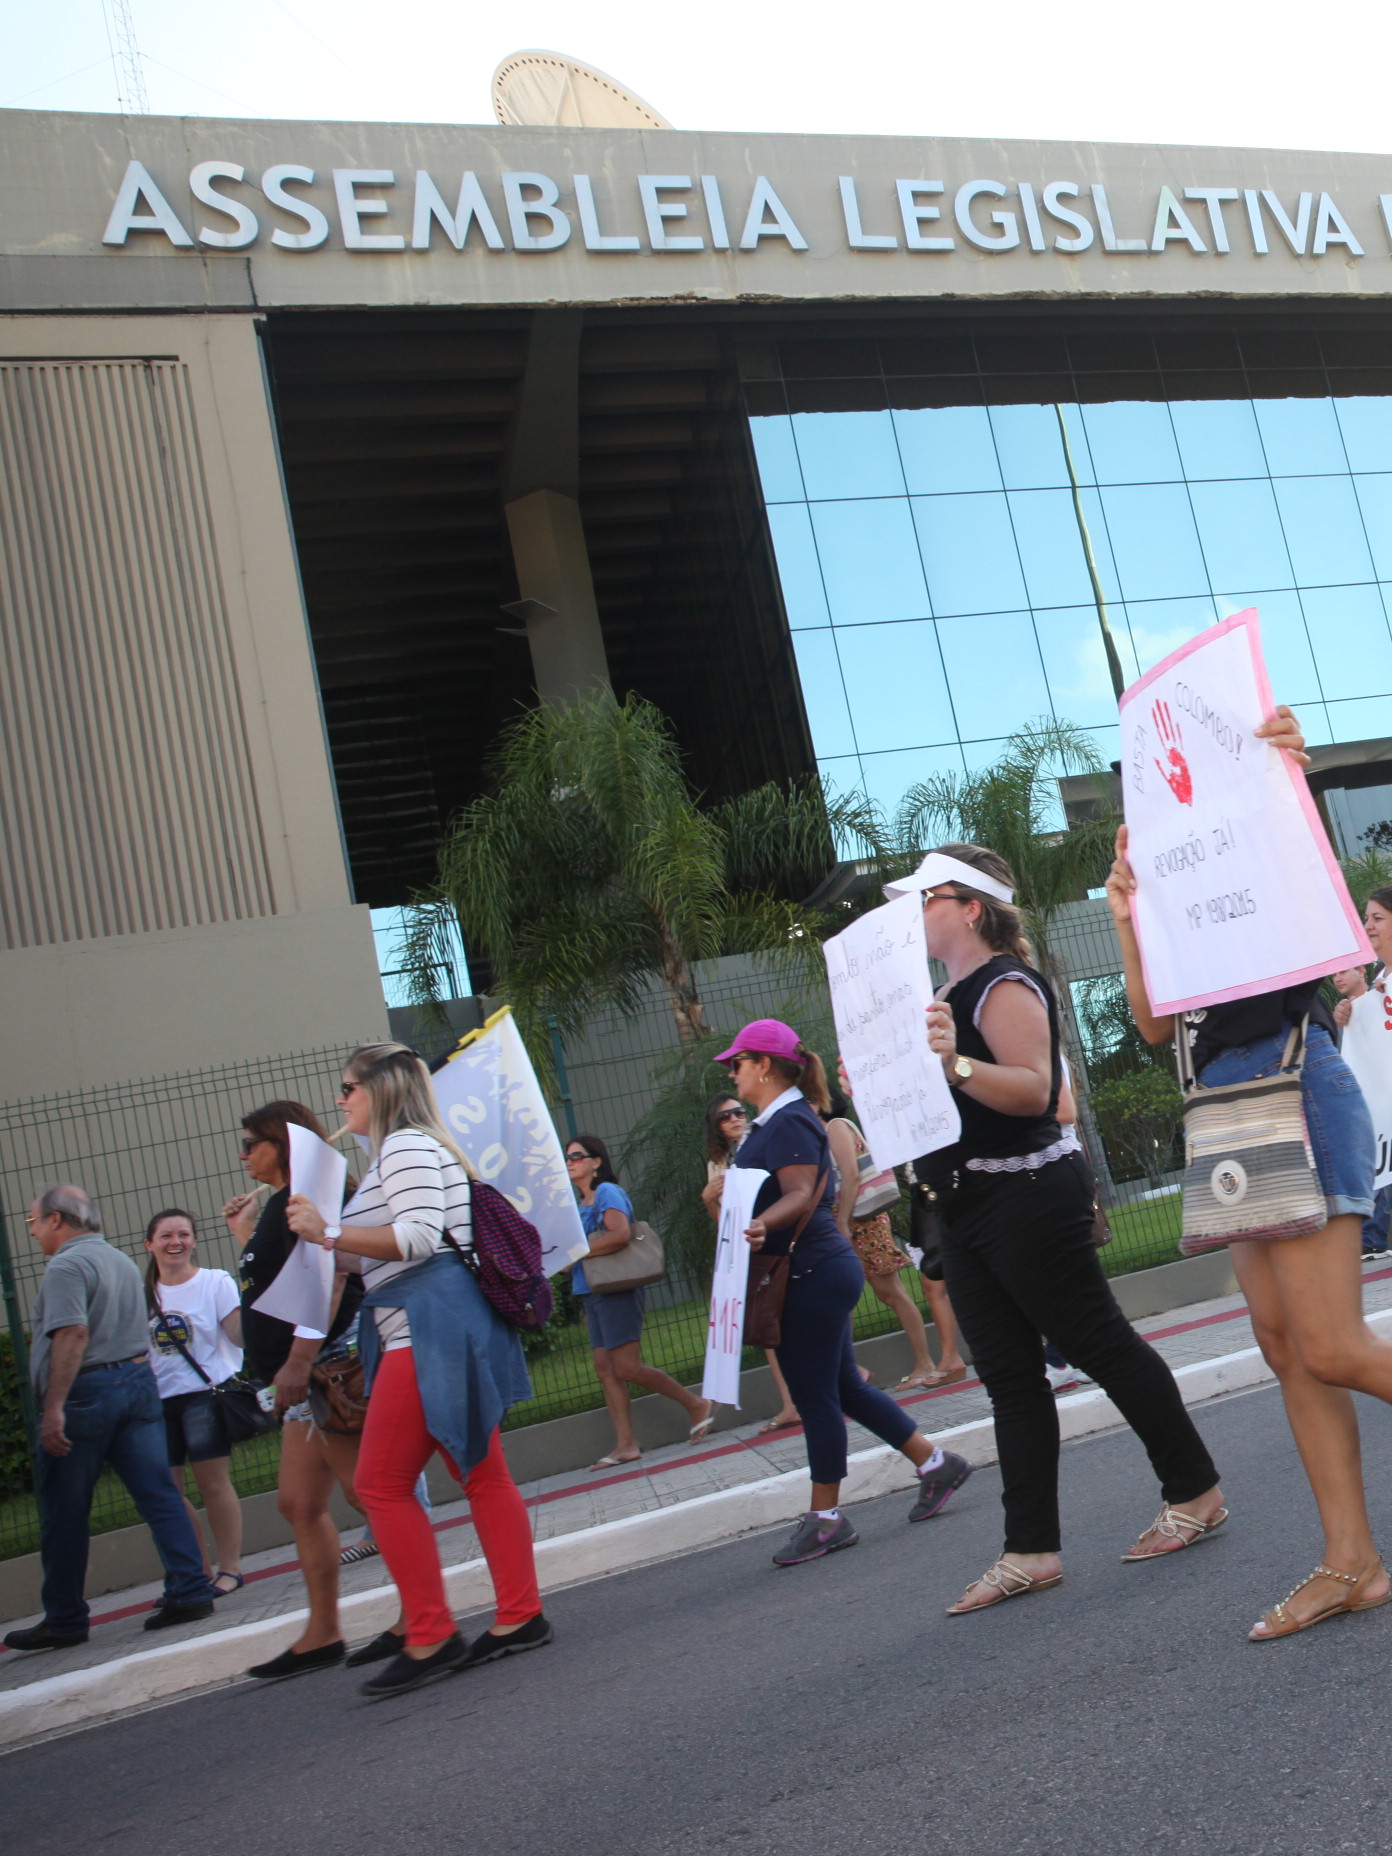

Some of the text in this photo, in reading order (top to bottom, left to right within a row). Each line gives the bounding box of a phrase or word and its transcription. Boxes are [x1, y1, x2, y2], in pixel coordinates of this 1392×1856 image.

[101, 160, 810, 253] ASSEMBLEIA
[838, 175, 1365, 256] LEGISLATIVA
[1132, 682, 1243, 794] BASTA COLOMBO!
[1153, 830, 1206, 878] REVOGAÇÃO
[1185, 903, 1202, 931] MP
